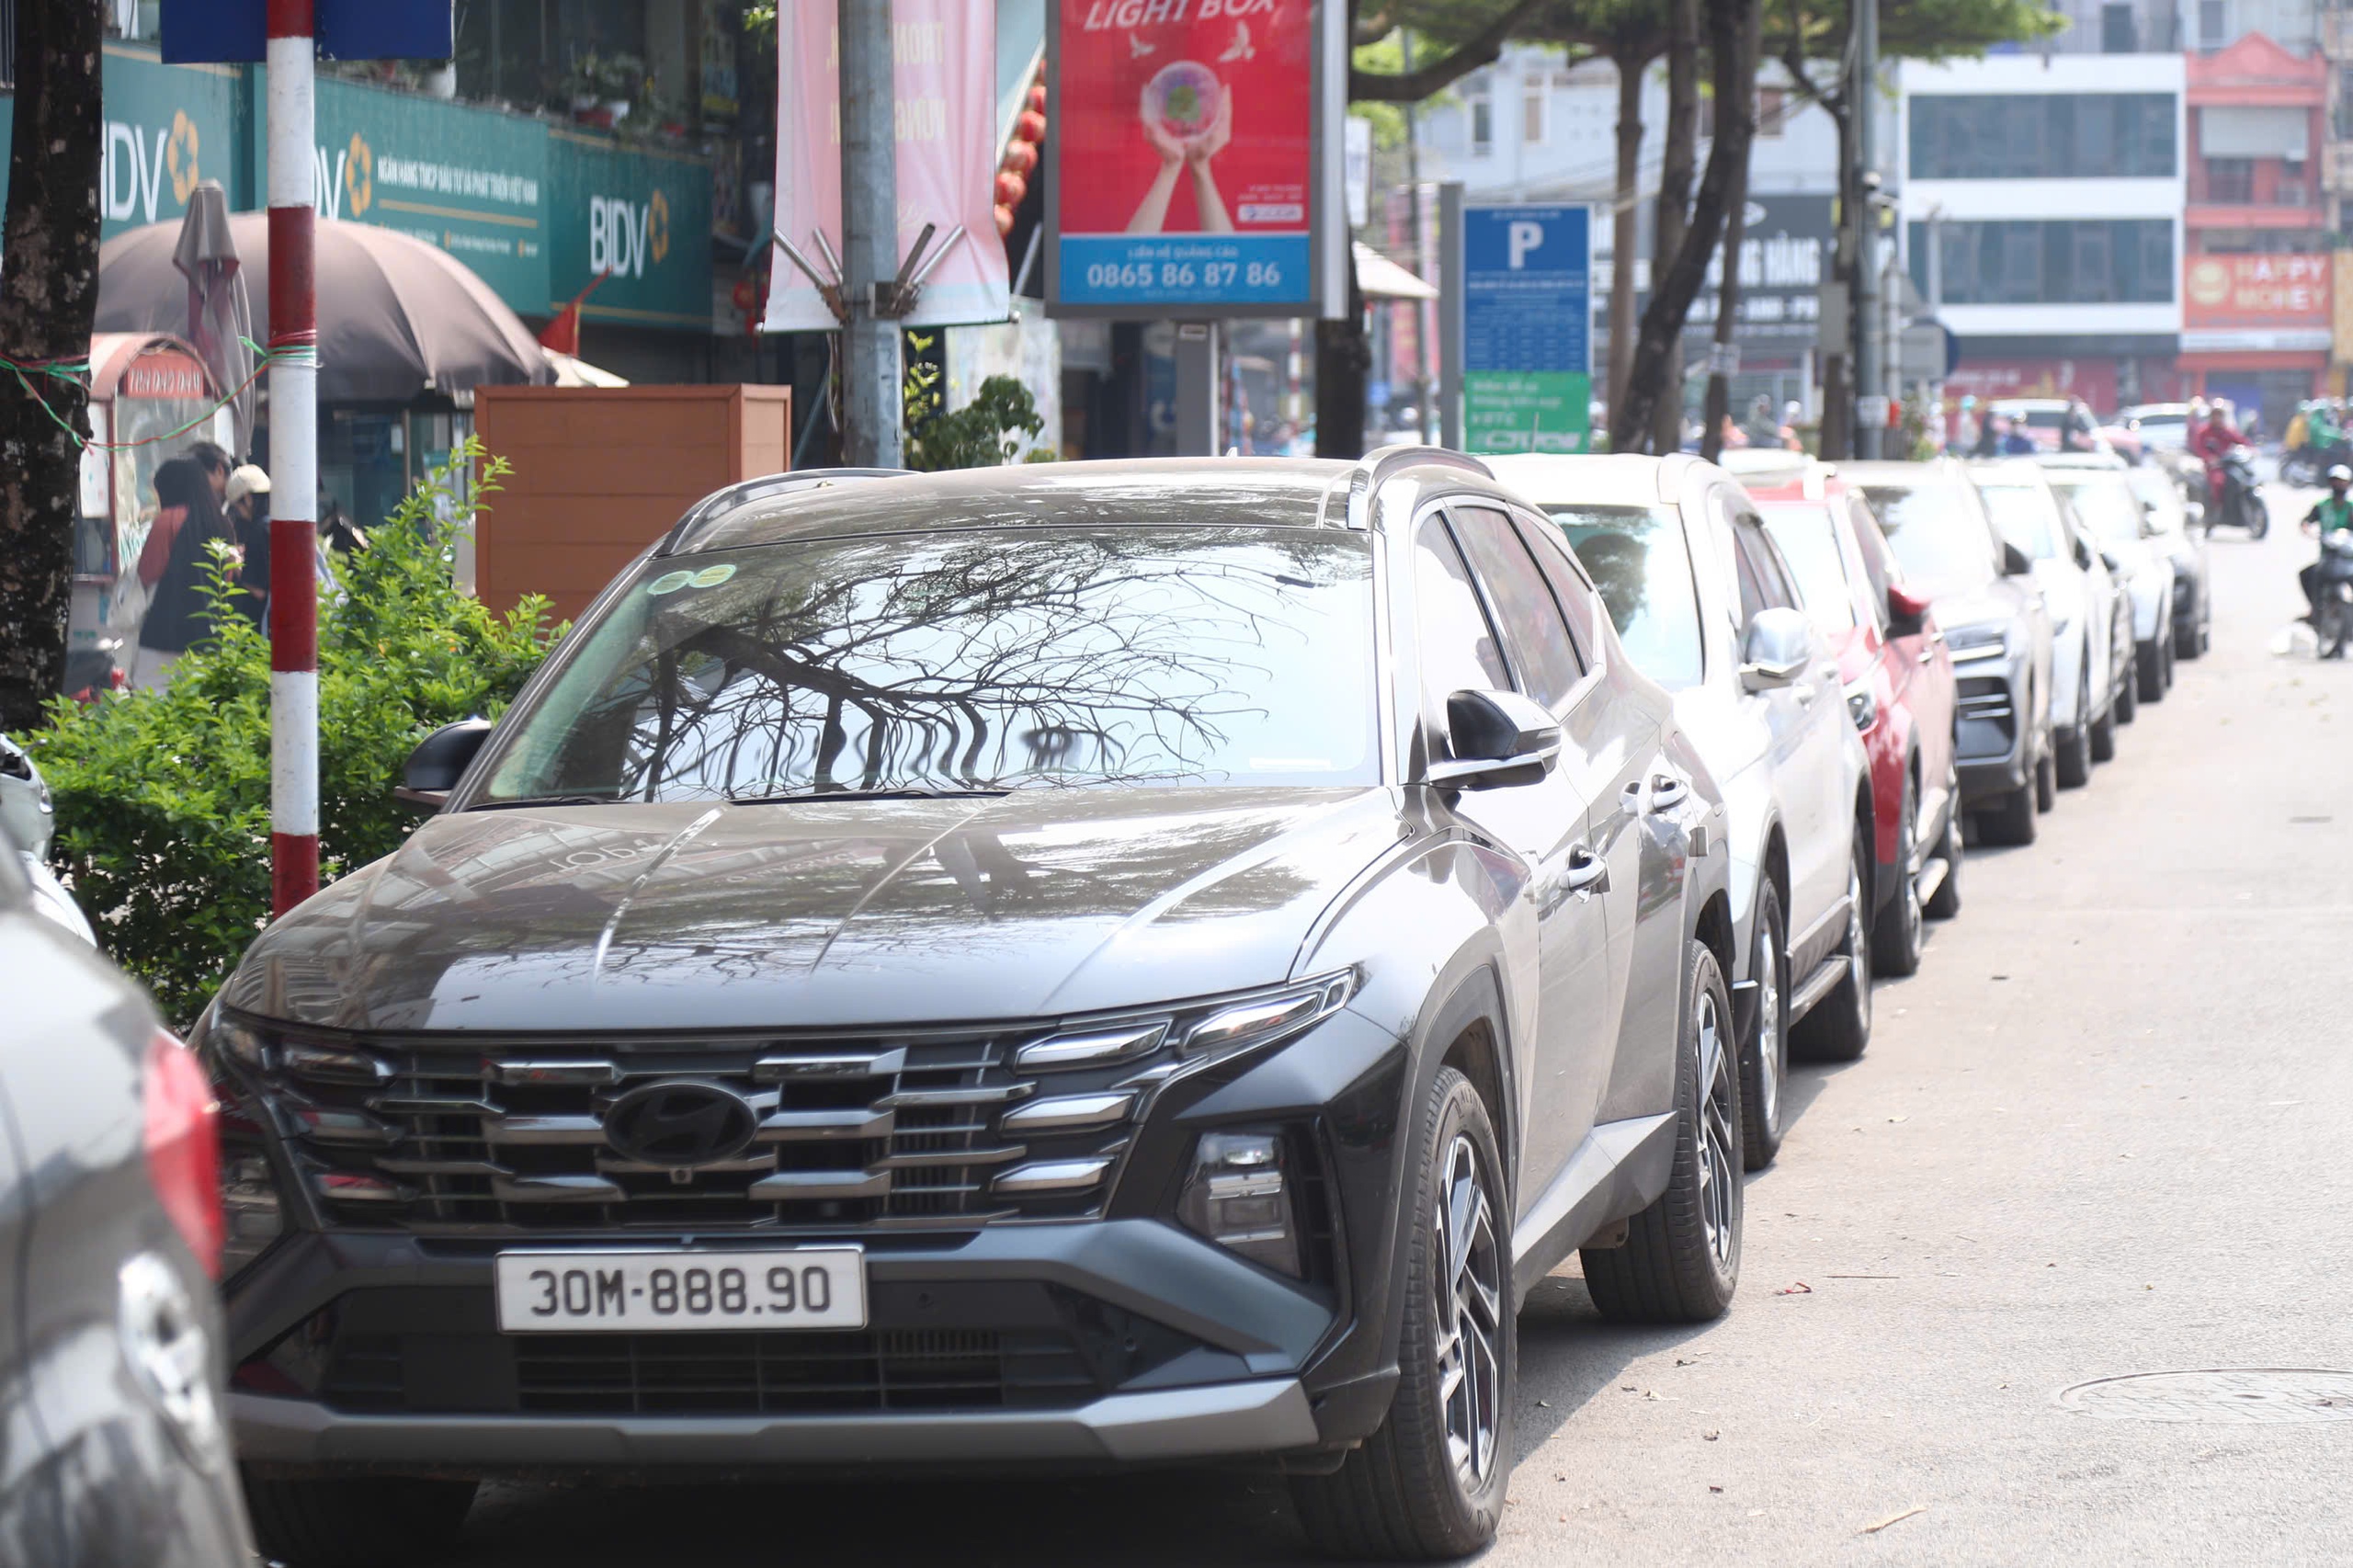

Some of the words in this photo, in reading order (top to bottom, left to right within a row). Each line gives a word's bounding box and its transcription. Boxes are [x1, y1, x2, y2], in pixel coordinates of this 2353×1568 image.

[1084, 0, 1188, 31] LIGHT
[101, 120, 168, 223] IDV
[590, 195, 649, 279] BIDV
[1509, 221, 1544, 269] P
[1087, 263, 1153, 288] 0865
[1162, 262, 1195, 287] 86
[1204, 261, 1237, 287] 87
[1245, 261, 1281, 287] 86
[2234, 256, 2326, 281] HAPPY
[529, 1266, 832, 1317] 30M-888.90
